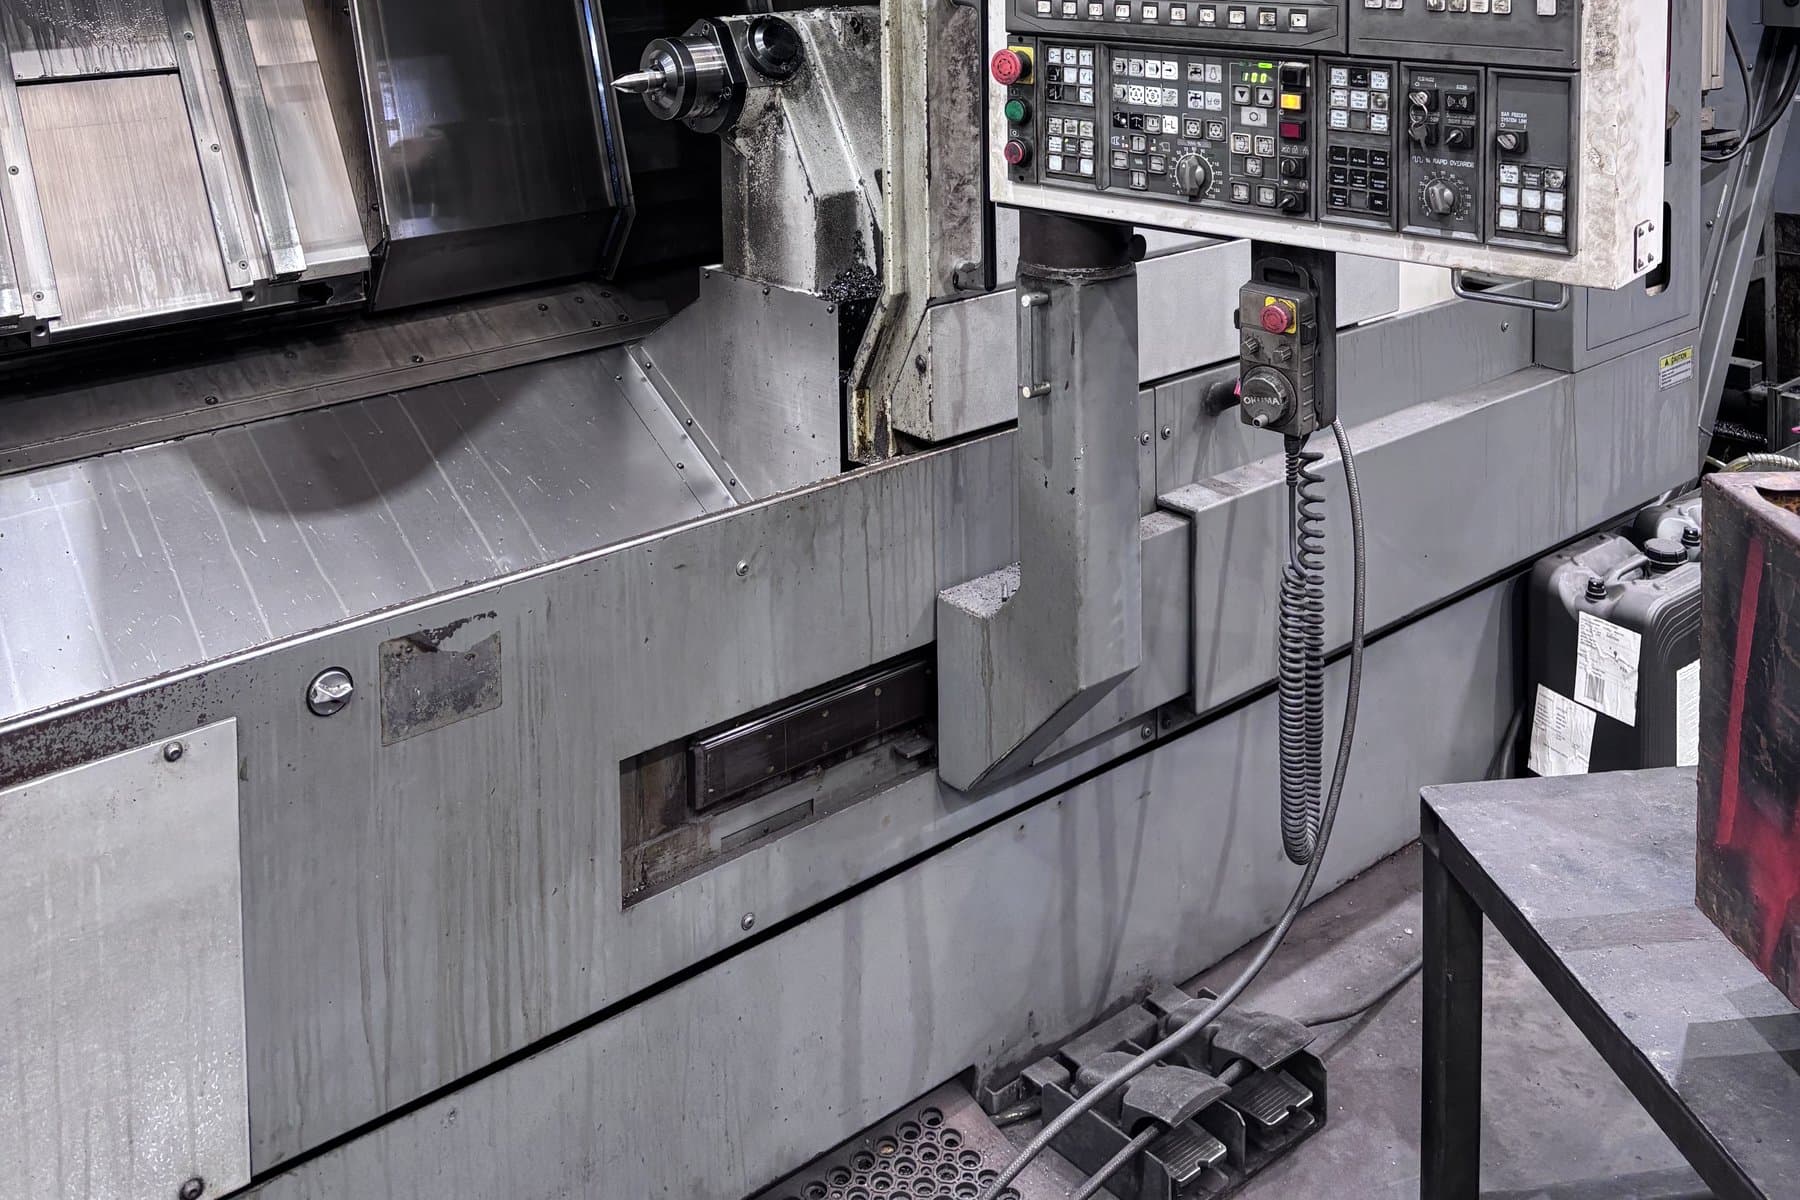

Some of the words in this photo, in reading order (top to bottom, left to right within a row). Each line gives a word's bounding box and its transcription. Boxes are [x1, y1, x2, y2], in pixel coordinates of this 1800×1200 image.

[1242, 72, 1267, 84] 100
[1432, 158, 1448, 166] RAPID
[1450, 159, 1475, 168] OVERRIDE
